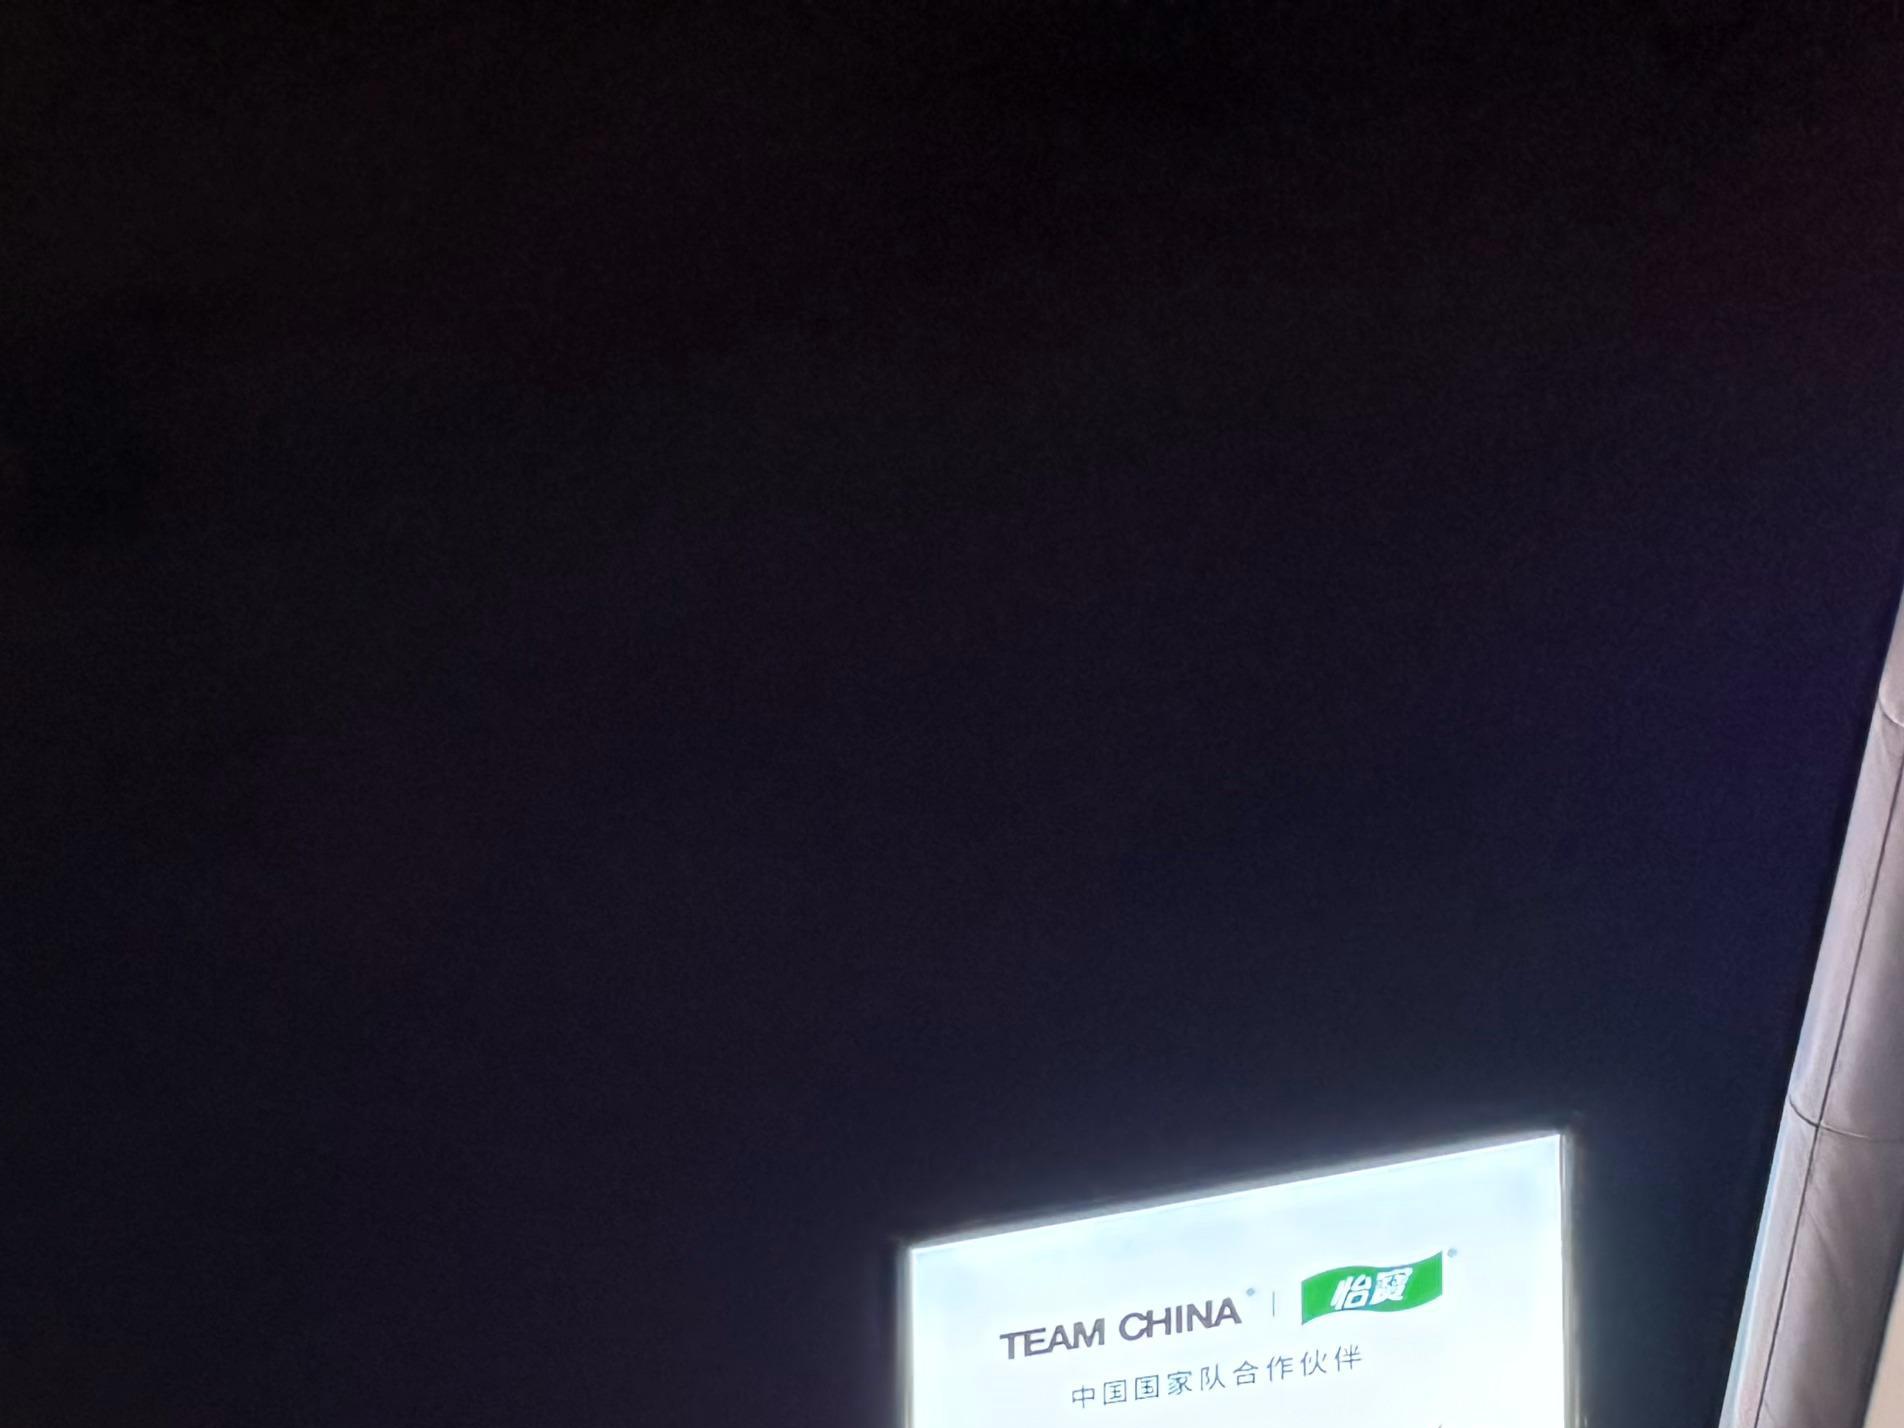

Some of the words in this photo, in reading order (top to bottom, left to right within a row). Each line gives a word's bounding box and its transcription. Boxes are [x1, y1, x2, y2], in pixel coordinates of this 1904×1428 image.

[999, 1317, 1106, 1360] TEAM
[1118, 1296, 1243, 1341] CHINA
[1071, 1343, 1363, 1408] 中国国家队合作伙伴
